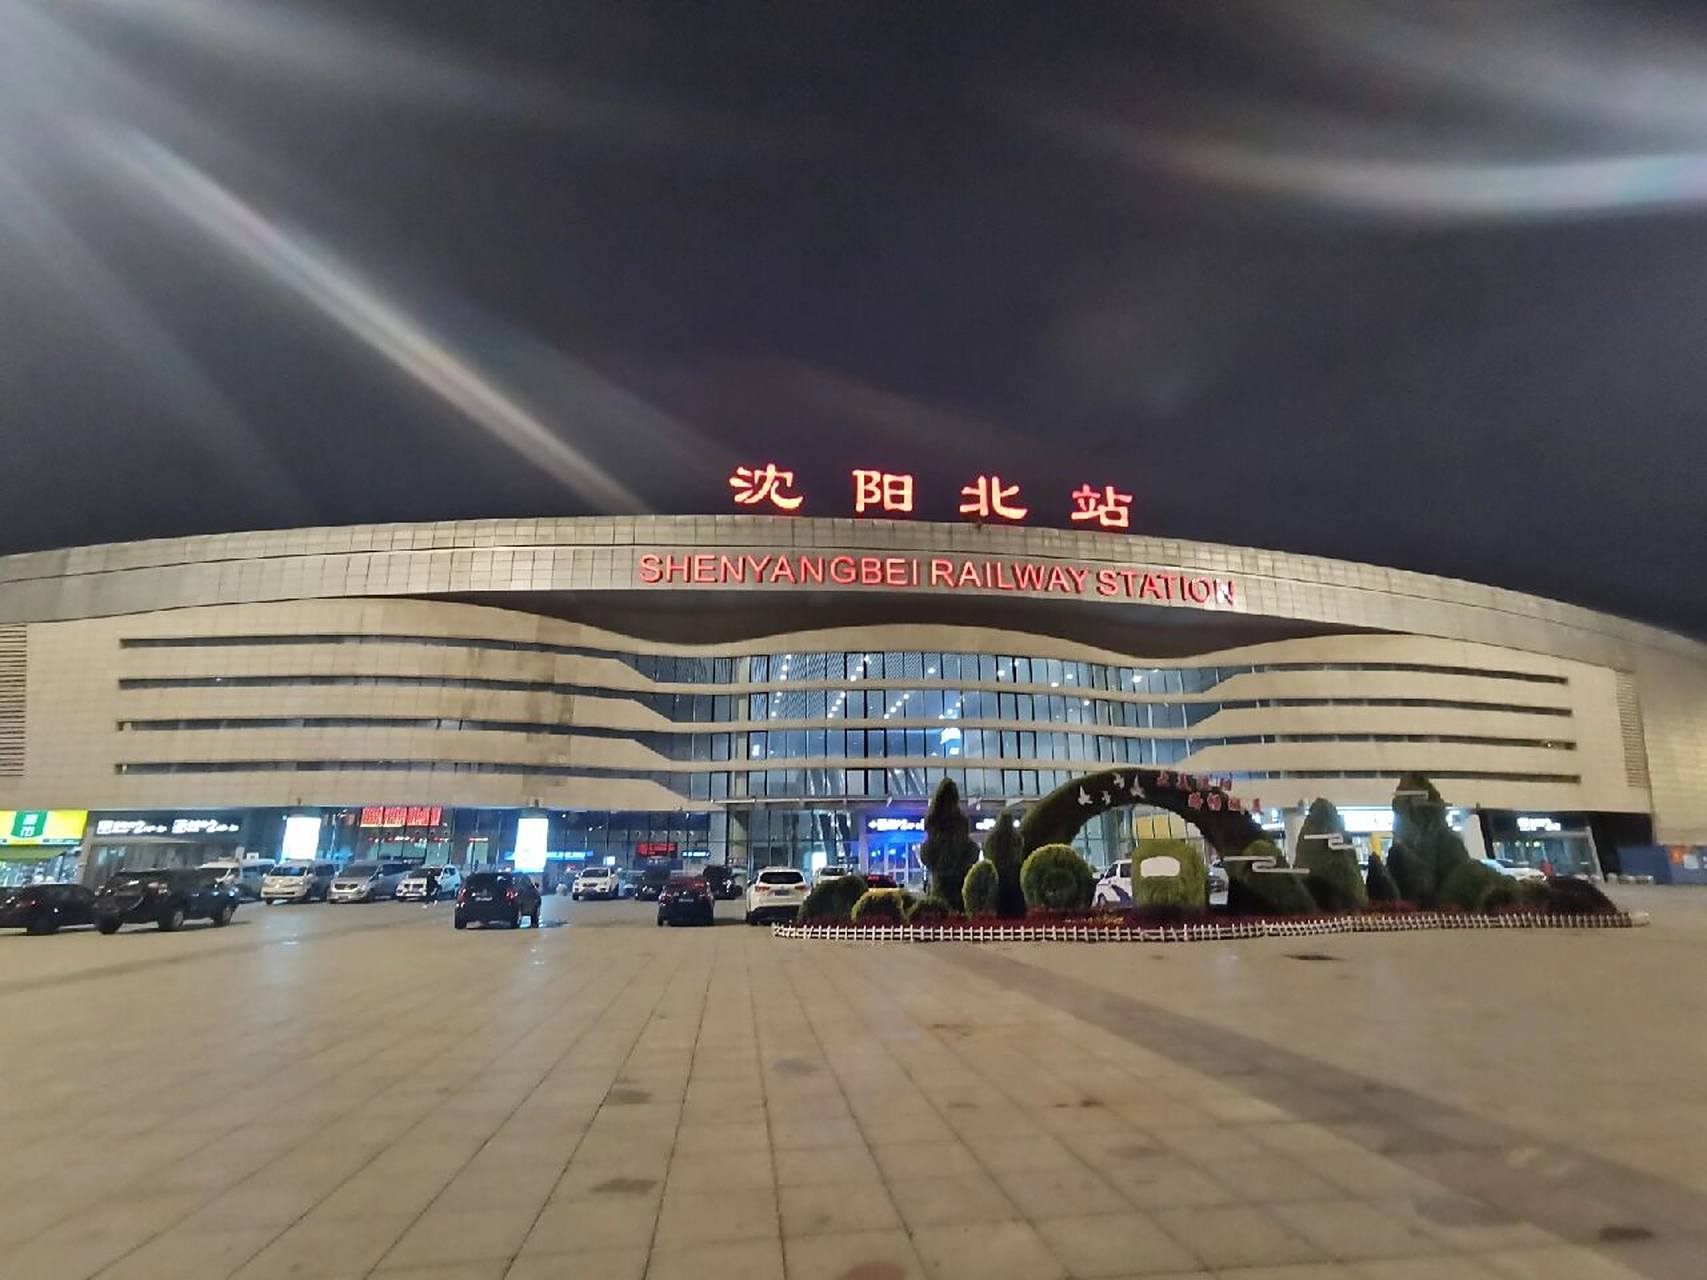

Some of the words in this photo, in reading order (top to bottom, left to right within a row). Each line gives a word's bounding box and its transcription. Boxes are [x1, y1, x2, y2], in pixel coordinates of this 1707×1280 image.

[728, 464, 1134, 529] 沈阳北站
[638, 552, 921, 587] SHENYANGBEI
[930, 558, 1090, 595] RAILWAY
[1096, 568, 1235, 607] STATION
